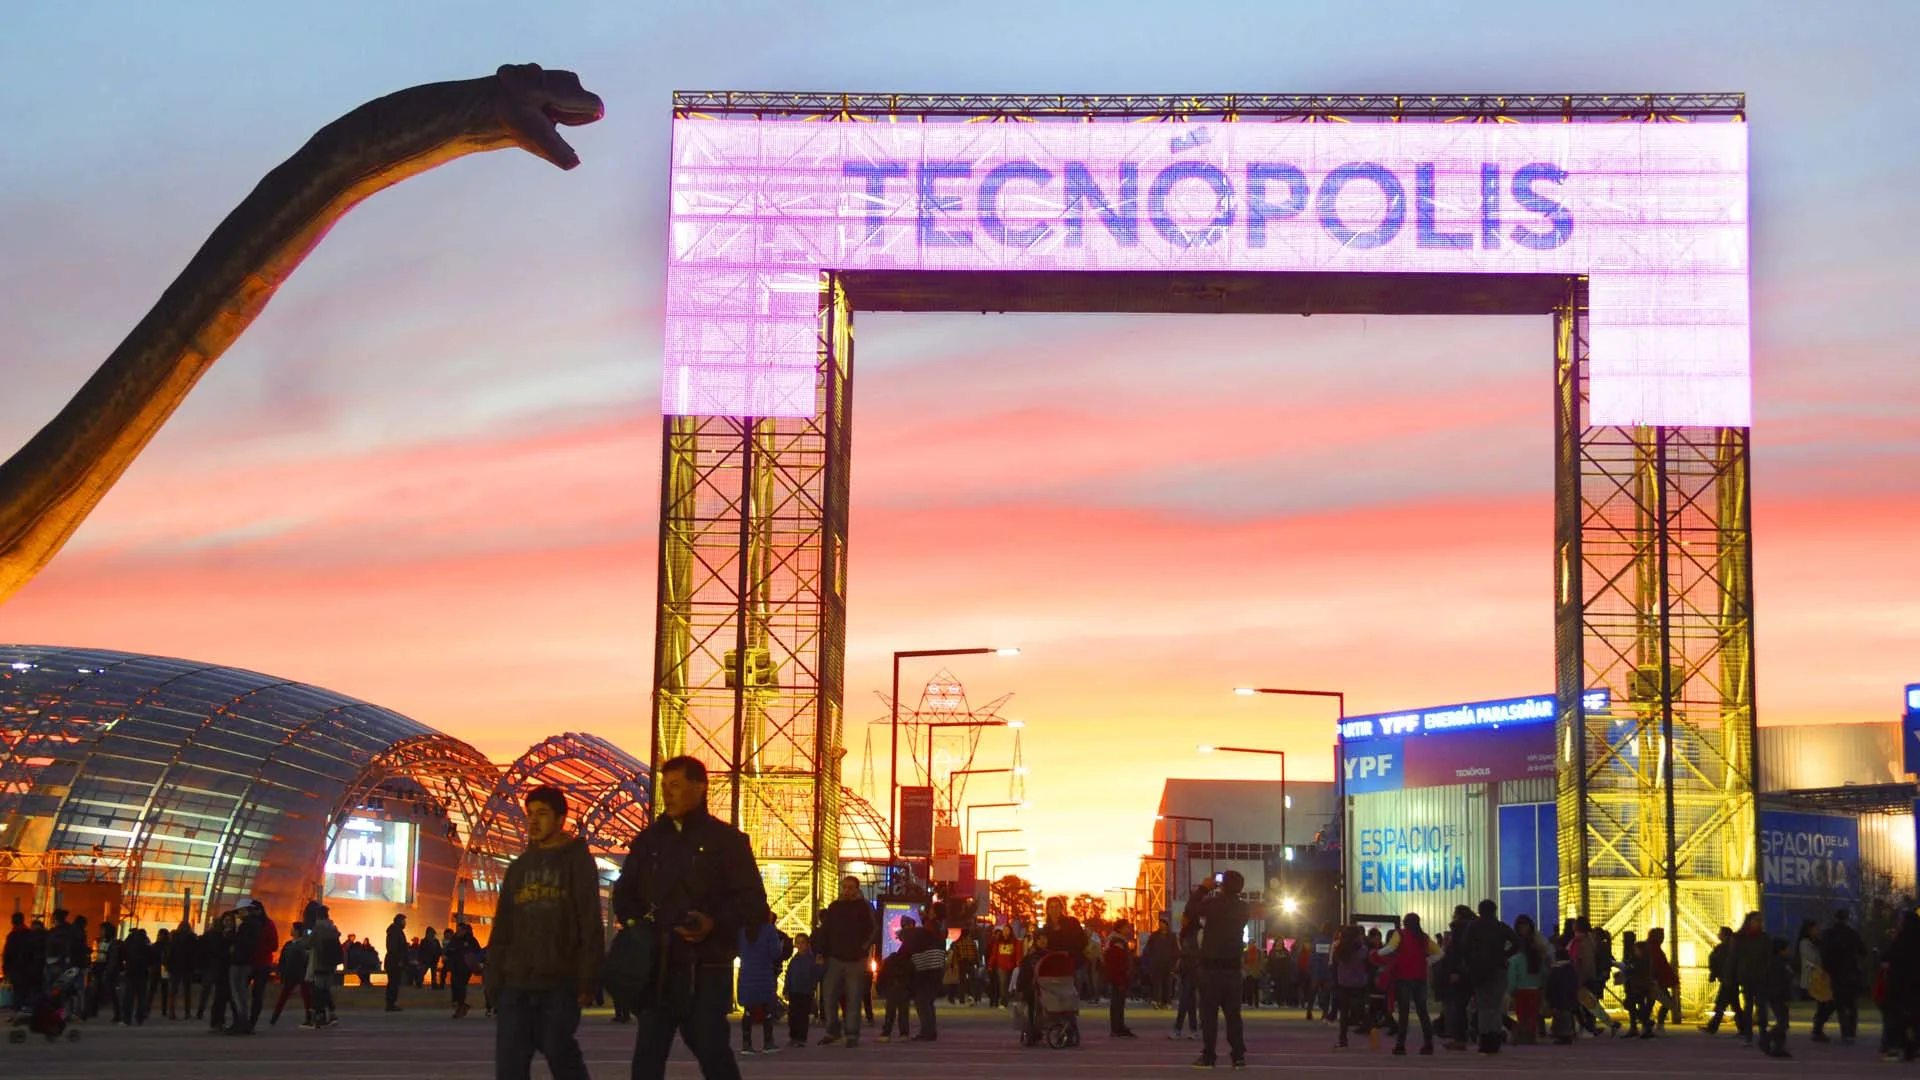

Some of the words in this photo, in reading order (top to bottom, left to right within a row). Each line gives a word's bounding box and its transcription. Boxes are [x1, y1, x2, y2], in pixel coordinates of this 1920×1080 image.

[842, 126, 1575, 250] TECNÓPOLIS
[1336, 721, 1373, 738] ARTIR
[1379, 714, 1420, 735] YPF
[1424, 705, 1476, 729] ENERGÍA
[1476, 702, 1507, 724] PARA
[1507, 698, 1553, 721] SOÑAR
[1343, 754, 1393, 780] YPF
[1360, 825, 1441, 856] ESPACIO
[1761, 830, 1825, 856] SPACIO
[1825, 835, 1837, 846] DE
[1361, 844, 1465, 893] ENERGÍA
[1763, 850, 1849, 889] NERGÍA
